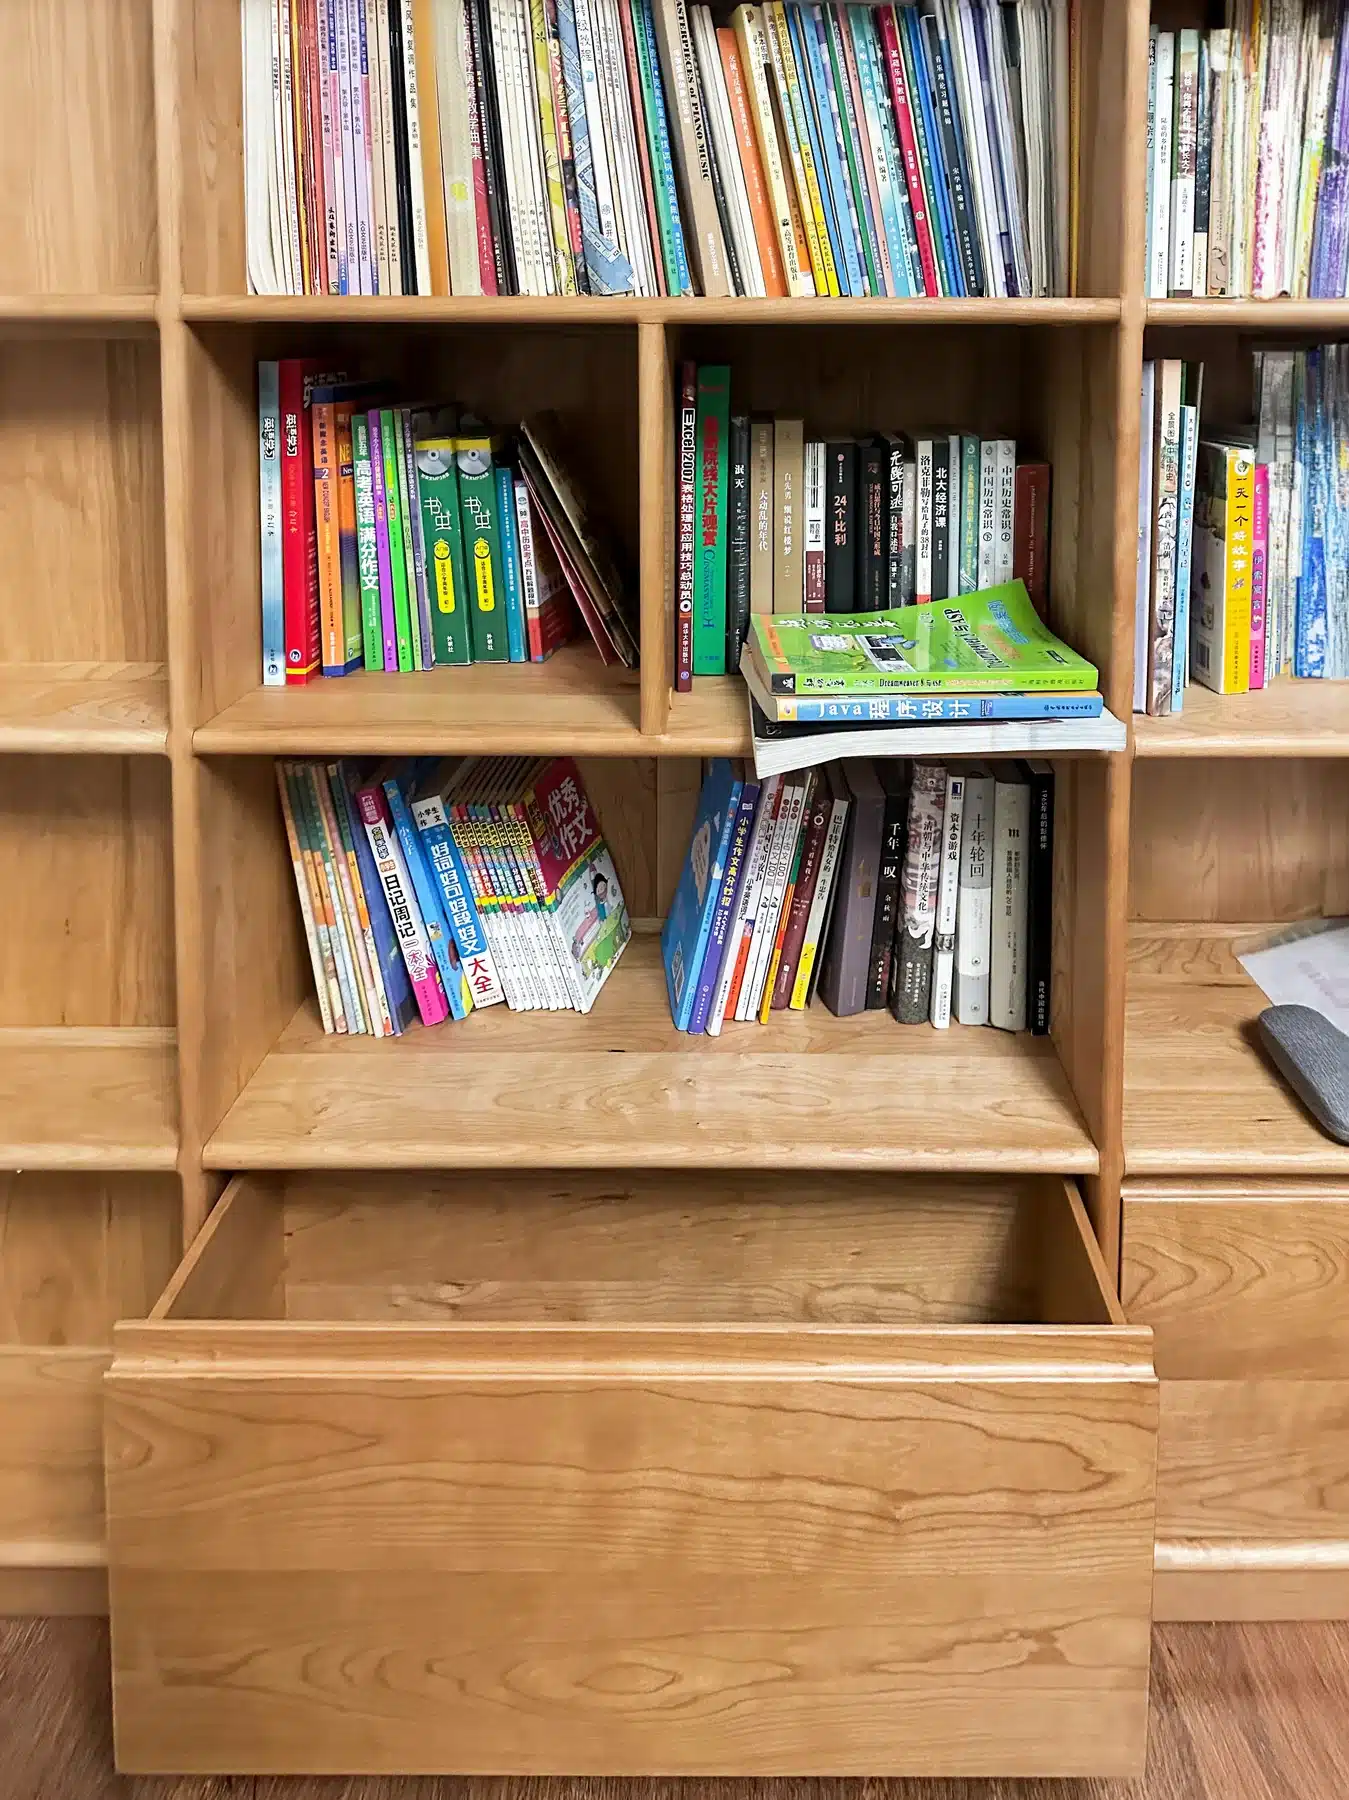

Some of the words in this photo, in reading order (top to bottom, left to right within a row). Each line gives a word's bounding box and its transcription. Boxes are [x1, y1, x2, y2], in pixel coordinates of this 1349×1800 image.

[891, 49, 905, 105] 基础乐理教程
[691, 102, 704, 140] PIANO
[681, 407, 696, 452] Excel
[320, 467, 330, 479] 2
[355, 459, 375, 525] 高考英语
[680, 453, 695, 484] 2007
[734, 464, 745, 489] 泯灭
[423, 495, 453, 532] 书虫
[463, 495, 493, 531] 书虫
[758, 489, 768, 552] 大动乱的年代
[834, 495, 848, 546] 24个比利
[920, 455, 932, 559] 洛克菲勒写给儿子的38封信
[935, 467, 948, 529] 北大经济课
[982, 465, 994, 530] 中国历史常识
[1001, 465, 1013, 530] 中国历史常识
[679, 484, 695, 600] 表格处理及应用技巧总动员
[783, 504, 793, 557] 细说红楼梦
[358, 527, 380, 591] 满分作文
[681, 622, 690, 664] 清华大学出版社
[819, 699, 863, 718] Java
[868, 698, 971, 719] 程序设计
[879, 678, 919, 688] Dreamweaver
[417, 806, 440, 818] 小学生
[547, 776, 581, 827] 优秀
[883, 822, 901, 879] 千年一叹
[947, 812, 961, 861] 资本的游戏
[970, 813, 987, 879] 十年轮回
[430, 841, 482, 955] 好词好句好段好文
[467, 957, 495, 995] 大全
